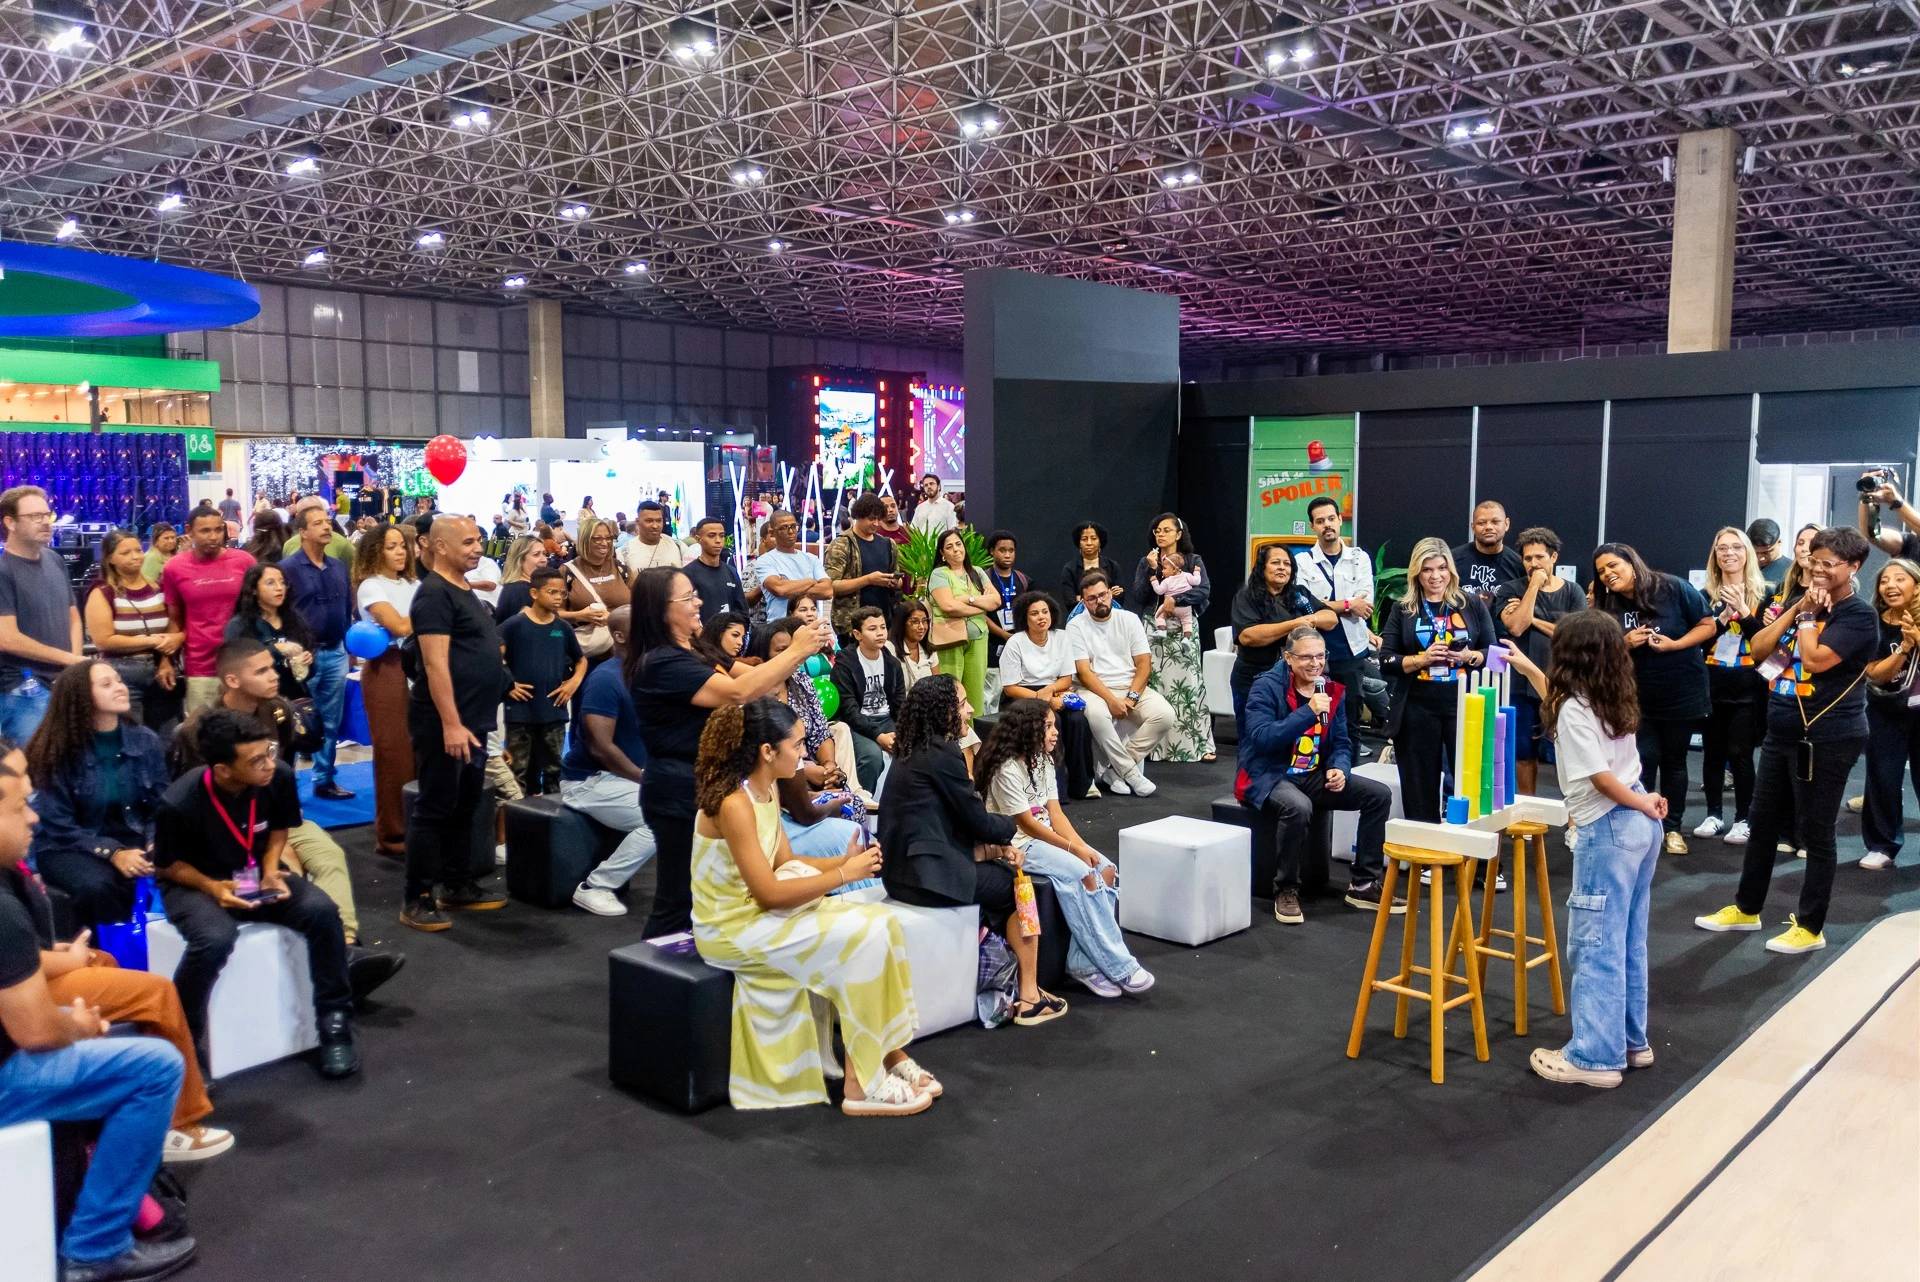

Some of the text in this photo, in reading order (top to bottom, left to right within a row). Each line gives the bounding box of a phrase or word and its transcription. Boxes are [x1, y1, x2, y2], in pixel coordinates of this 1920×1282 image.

[1258, 471, 1291, 488] SALA
[1261, 474, 1342, 507] SPOILER
[1470, 564, 1496, 583] MK
